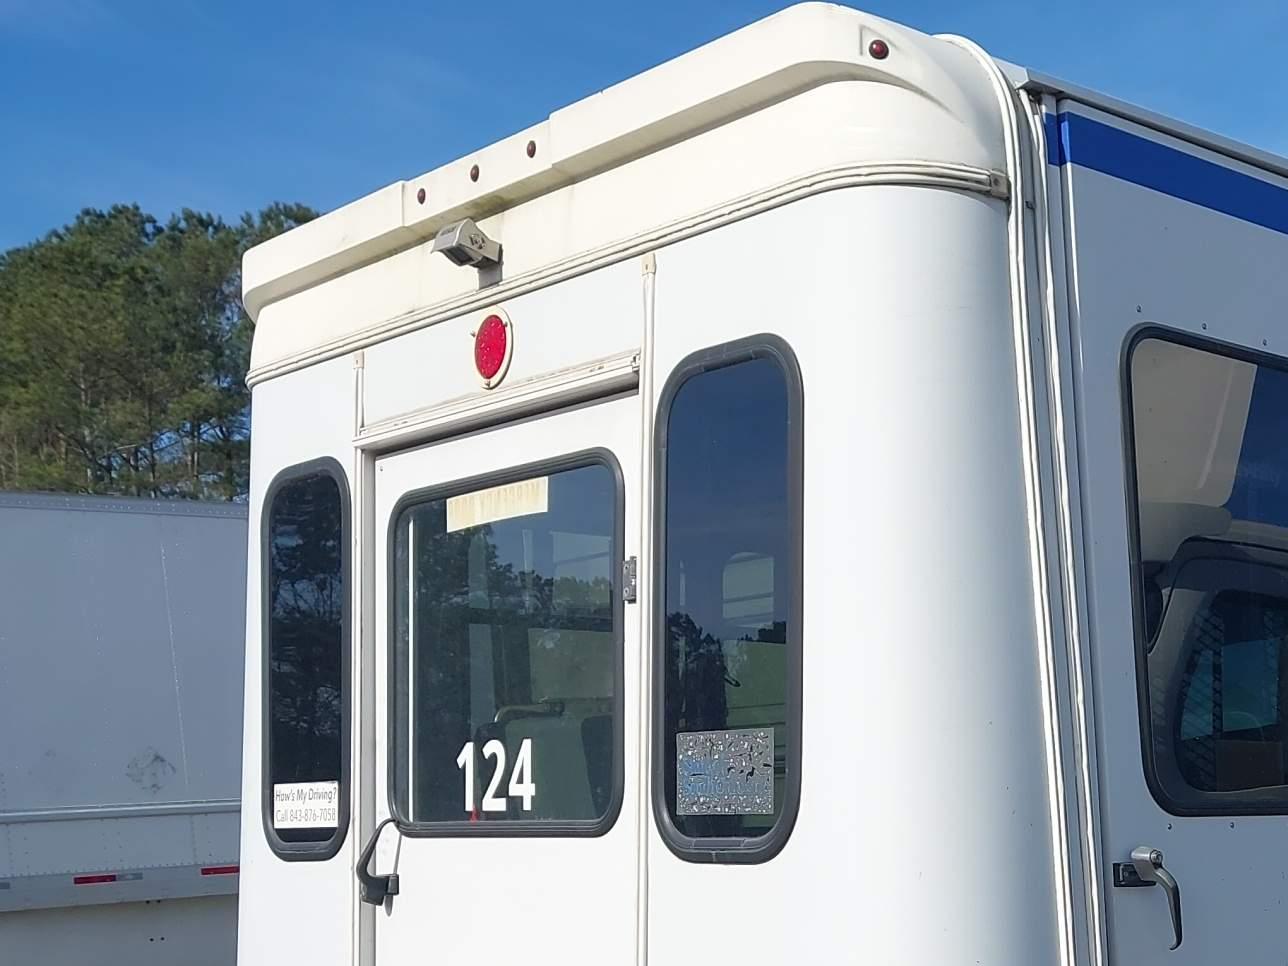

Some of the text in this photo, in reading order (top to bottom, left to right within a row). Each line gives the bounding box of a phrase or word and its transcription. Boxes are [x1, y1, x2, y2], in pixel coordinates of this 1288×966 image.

[456, 738, 536, 811] 124
[275, 787, 337, 805] How's My Driving?
[276, 808, 336, 822] Call 843-876-7058
